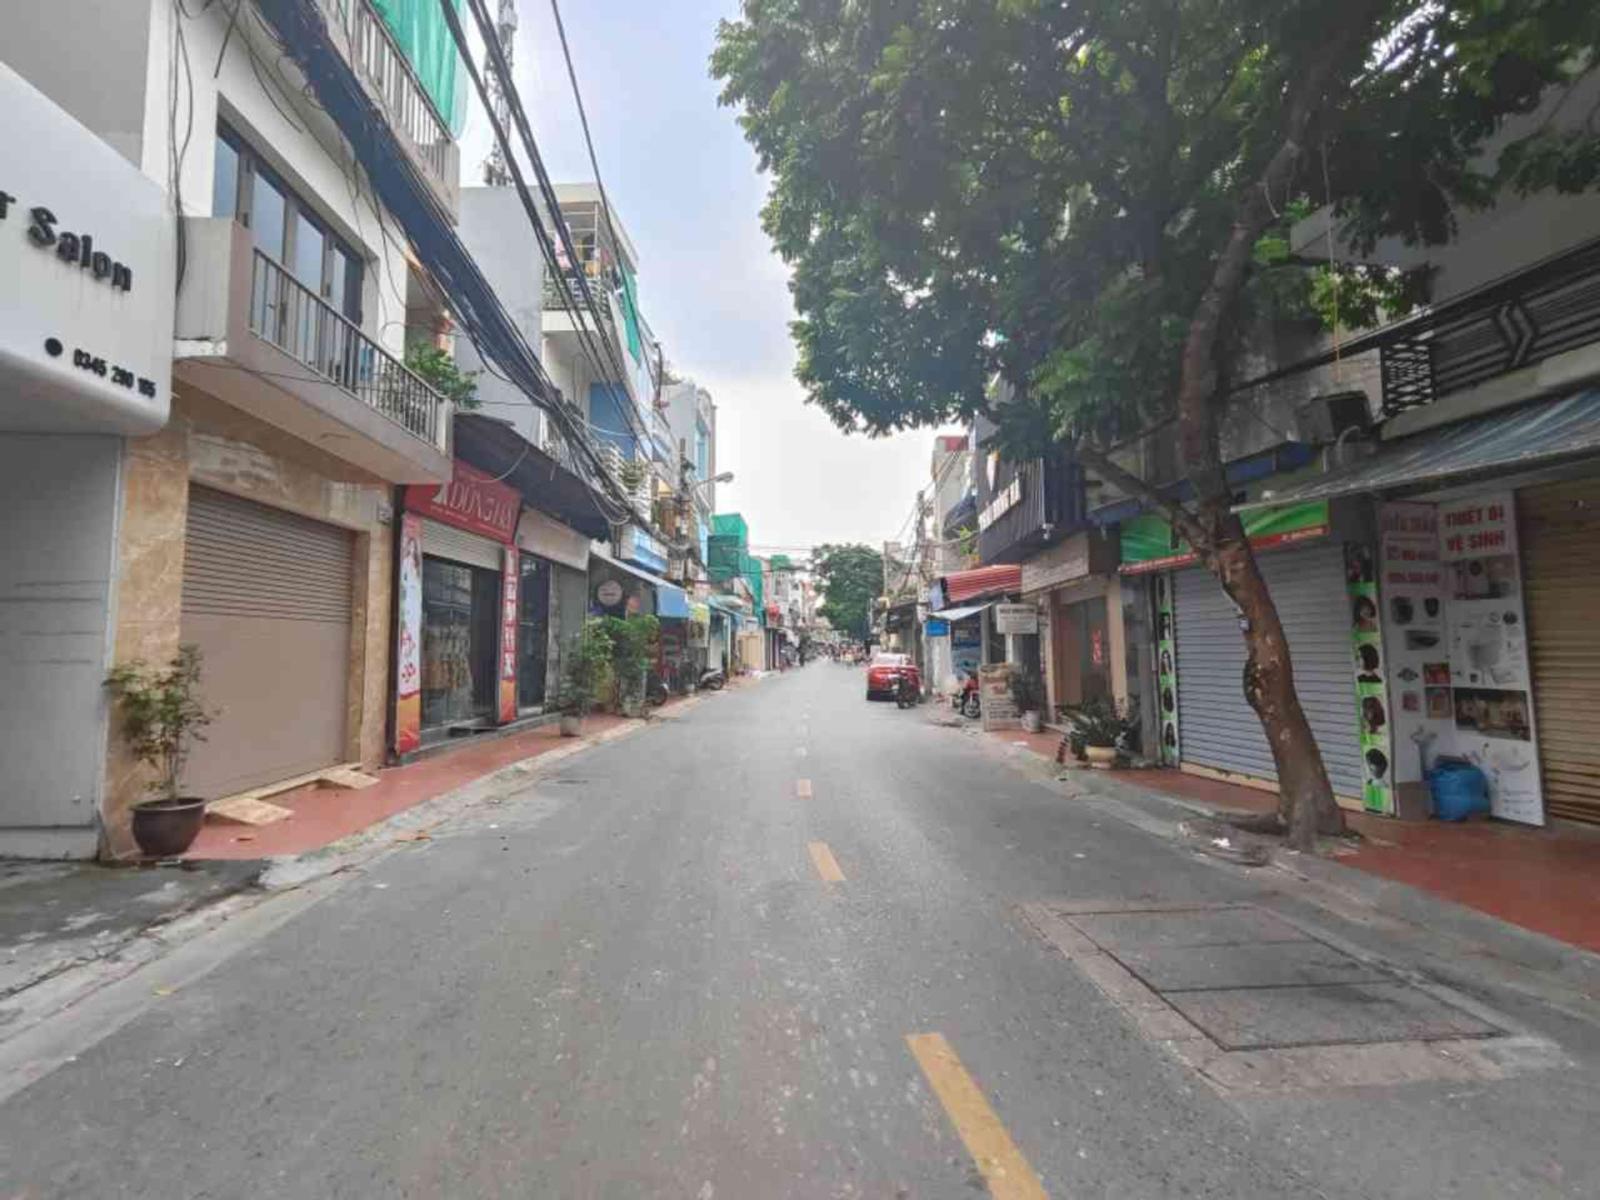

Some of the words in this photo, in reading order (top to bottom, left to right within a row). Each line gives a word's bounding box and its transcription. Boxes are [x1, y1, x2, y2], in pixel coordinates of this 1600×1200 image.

[26, 206, 132, 292] Salon
[73, 348, 107, 378] 0345
[1468, 530, 1505, 551] SINH
